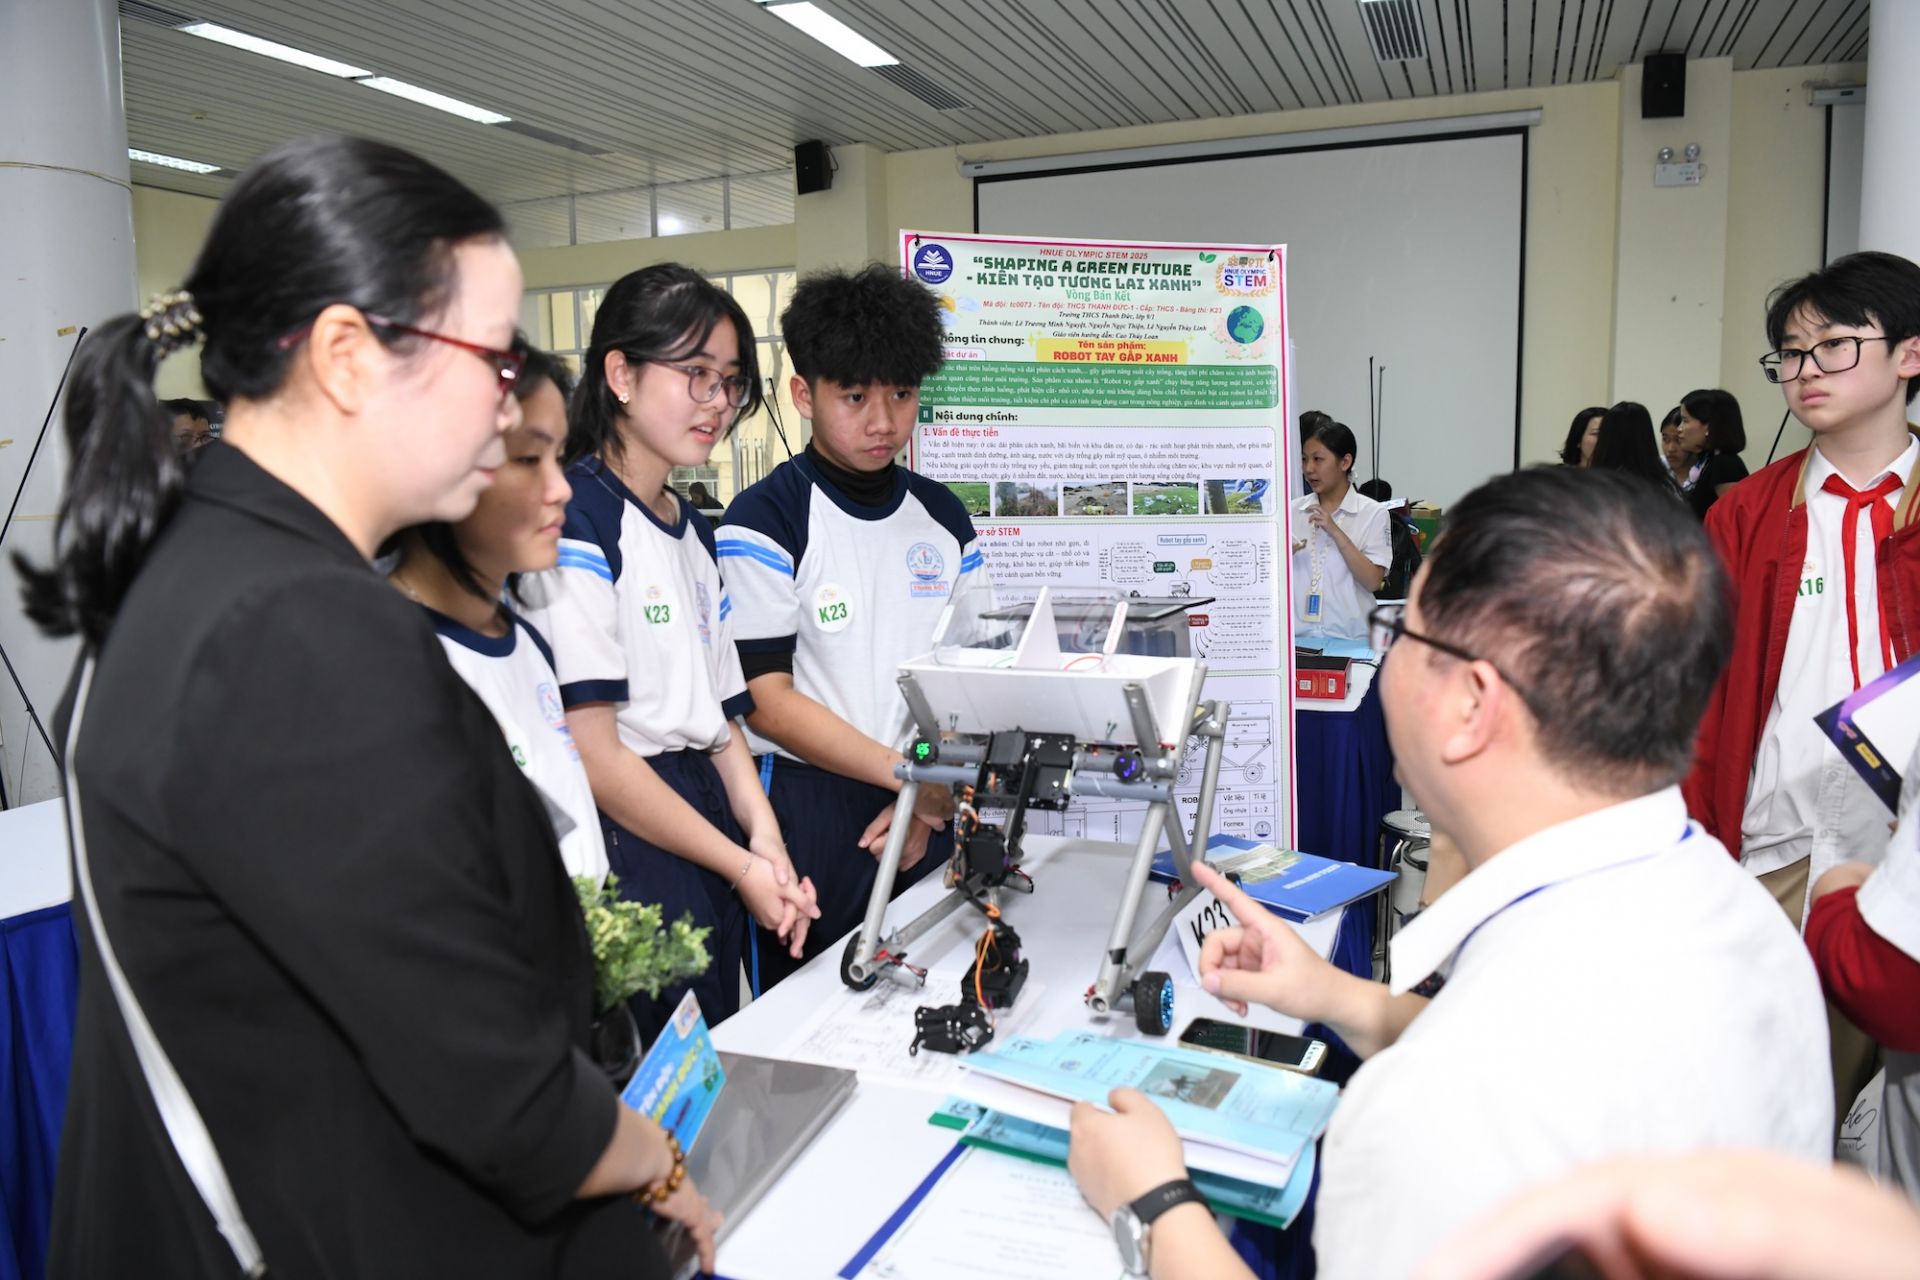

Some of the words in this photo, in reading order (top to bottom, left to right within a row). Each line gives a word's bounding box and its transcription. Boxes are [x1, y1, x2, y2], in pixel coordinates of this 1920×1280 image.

[1040, 249, 1063, 257] HNUE
[1066, 250, 1103, 258] OLYMPIC
[1130, 252, 1148, 260] 2025
[1062, 260, 1072, 273] A
[1076, 261, 1127, 275] GREEN
[1132, 262, 1192, 276] FUTURE
[1022, 275, 1054, 290] TẠO
[1057, 275, 1111, 290] TƯƠNG
[1115, 278, 1145, 290] LAI
[1224, 274, 1266, 287] STEM
[940, 332, 969, 346] hông
[971, 333, 986, 343] tin
[988, 335, 1025, 347] chung:
[1053, 351, 1092, 361] ROBOT
[1095, 352, 1116, 361] TAY
[1145, 353, 1178, 363] XANH
[935, 410, 954, 423] Nội
[955, 411, 983, 423] dung
[998, 527, 1020, 536] STEM
[643, 604, 670, 624] K23
[818, 602, 848, 623] K23
